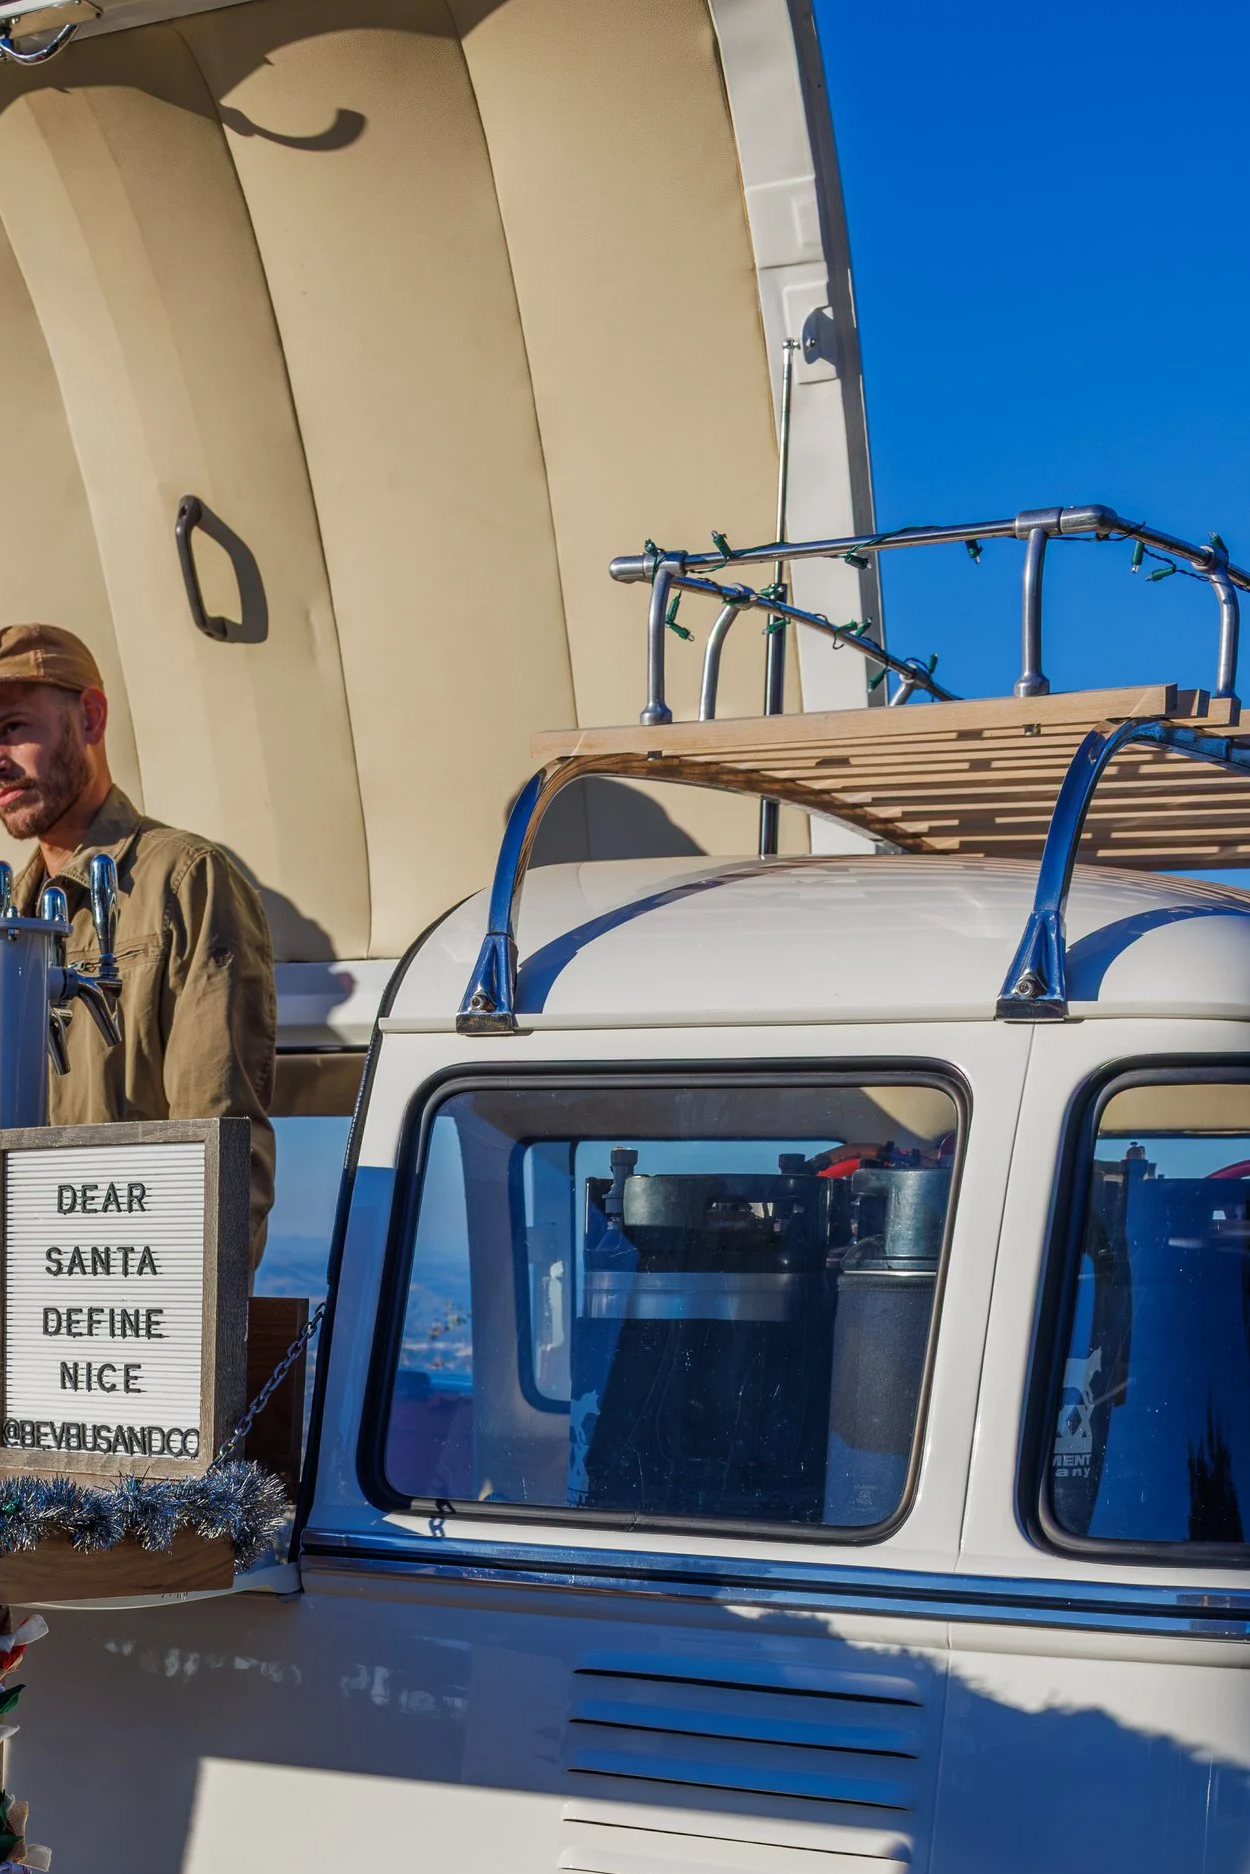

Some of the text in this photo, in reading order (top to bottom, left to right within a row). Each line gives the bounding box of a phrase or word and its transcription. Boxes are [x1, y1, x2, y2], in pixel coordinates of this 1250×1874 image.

[58, 1182, 147, 1214] DEAR
[46, 1246, 159, 1277] SANTA
[43, 1307, 164, 1338] DEFINE
[60, 1362, 143, 1393] NICE
[3, 1418, 200, 1458] @BEVBUSANDCO
